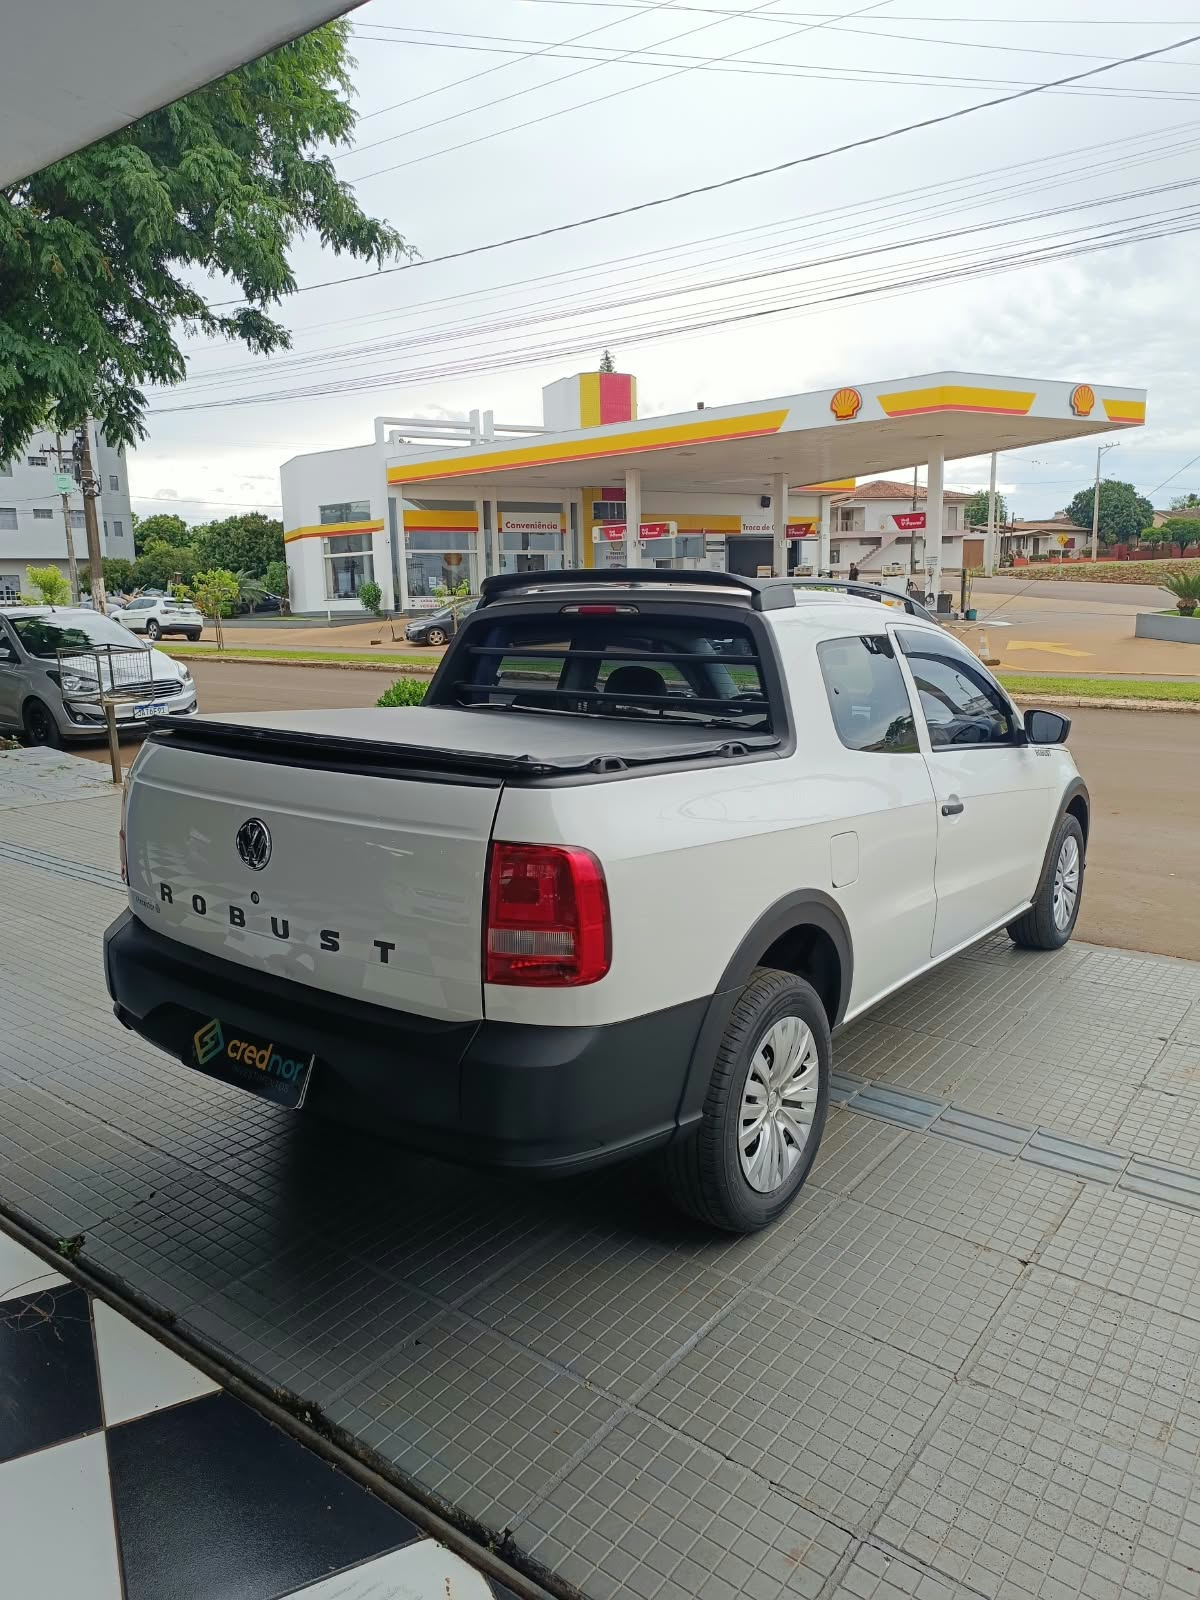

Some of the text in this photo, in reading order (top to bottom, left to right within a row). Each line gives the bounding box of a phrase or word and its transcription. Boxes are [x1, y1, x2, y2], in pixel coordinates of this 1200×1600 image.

[505, 521, 558, 530] Conveniência
[742, 523, 761, 531] Troca
[761, 523, 770, 531] de
[160, 883, 395, 963] ROBUST
[227, 1039, 304, 1081] crednor
